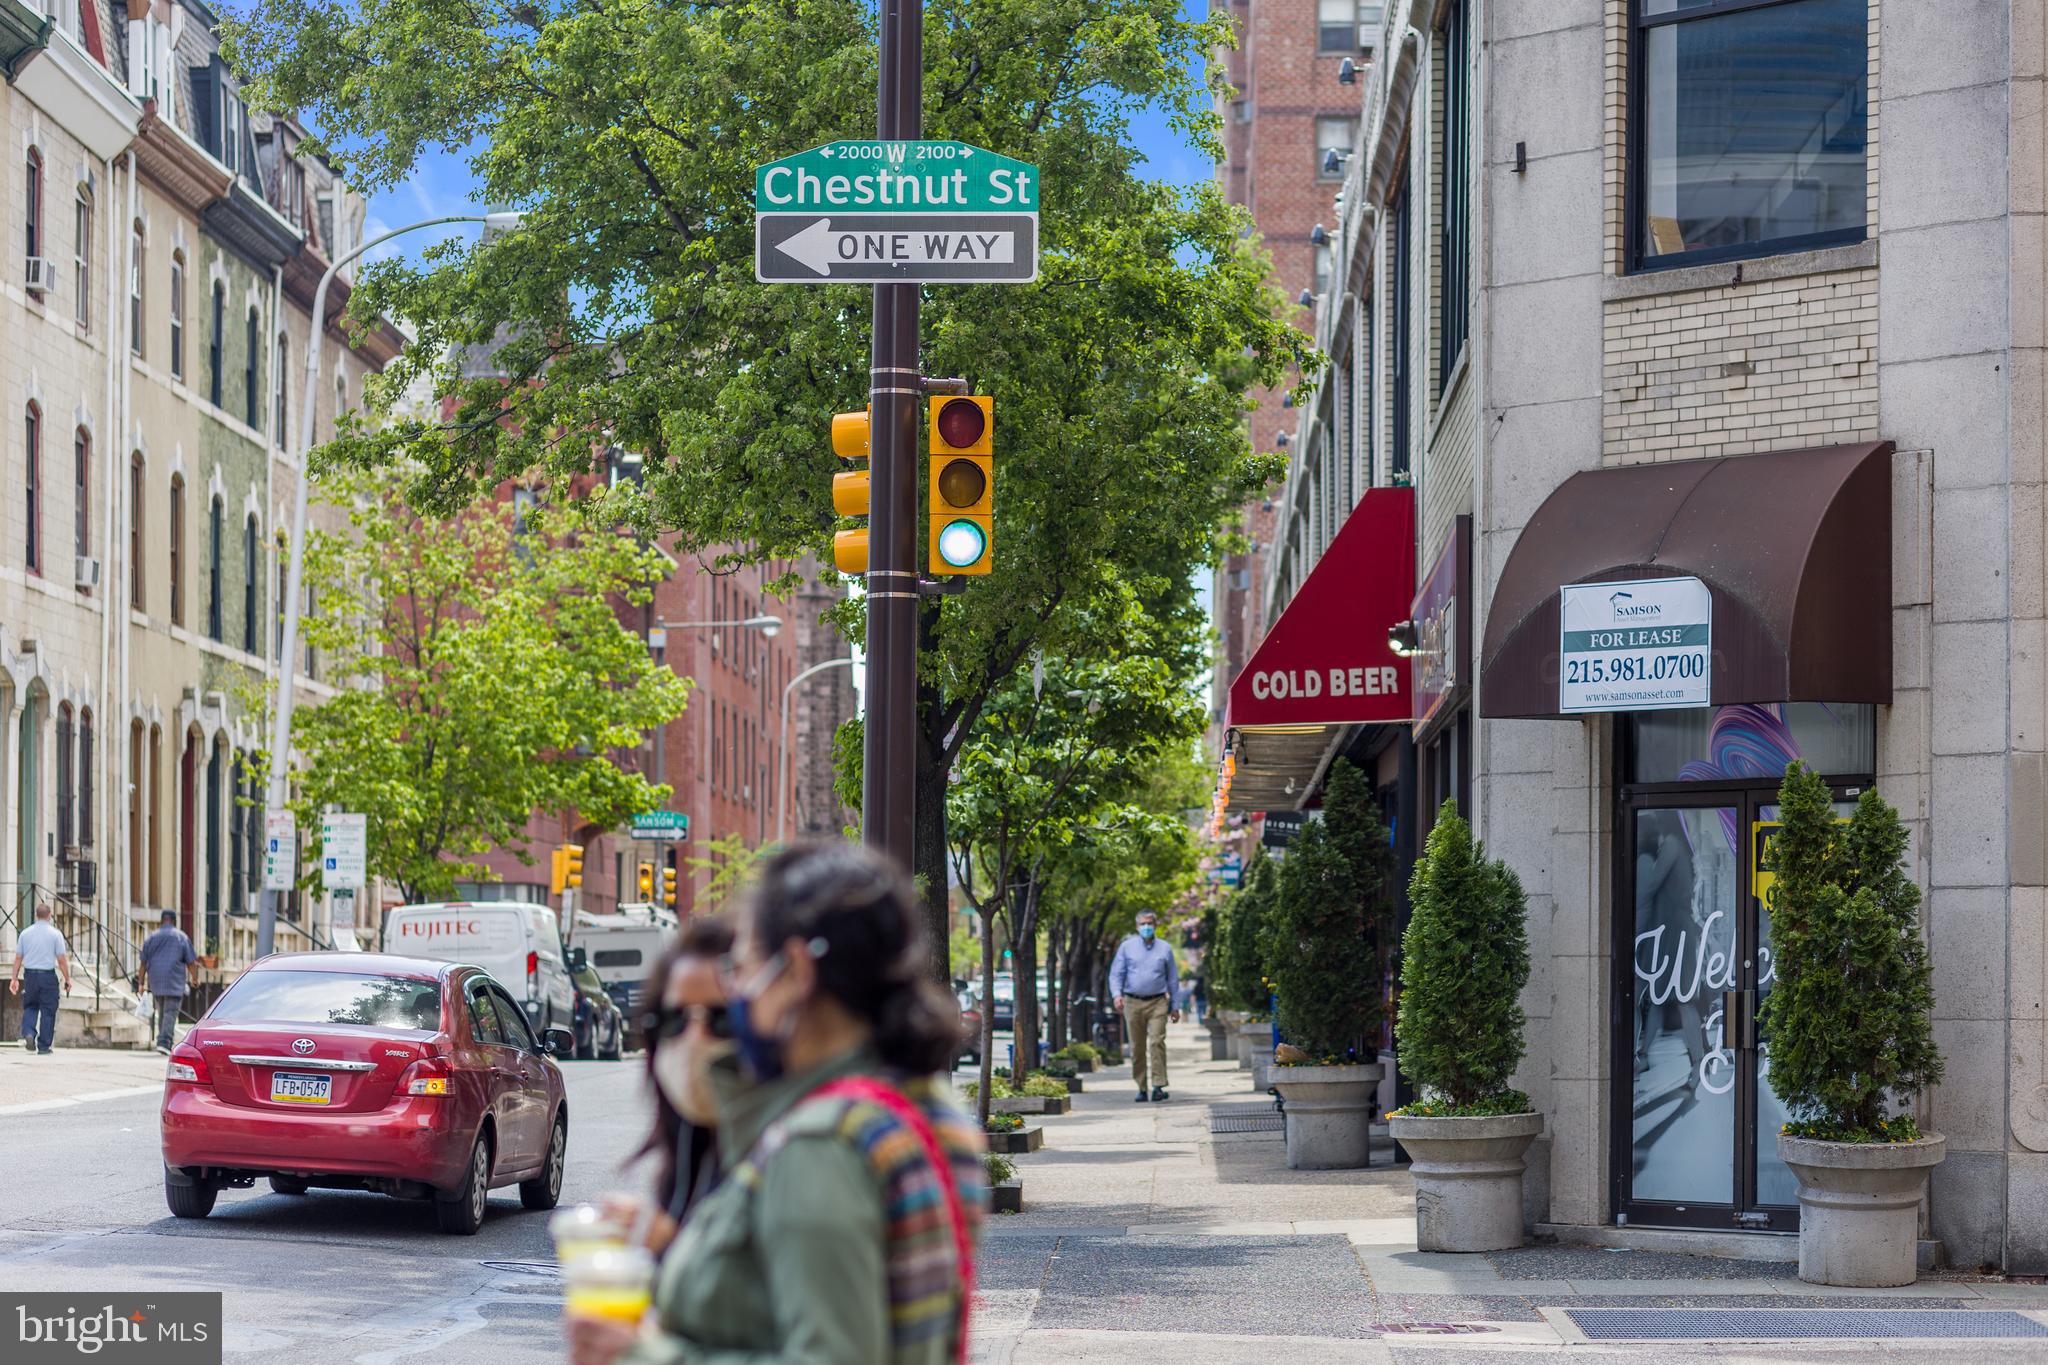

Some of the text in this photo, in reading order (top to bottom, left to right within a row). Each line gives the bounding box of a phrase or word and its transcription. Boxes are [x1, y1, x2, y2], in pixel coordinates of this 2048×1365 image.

[838, 143, 956, 163] 2000 W 2100
[763, 166, 1031, 205] Chestnut St
[837, 234, 1000, 260] ONE WAY
[1616, 604, 1662, 616] SAMSON
[1590, 629, 1682, 648] FOR LEASE
[1567, 653, 1704, 684] 215.981.0700
[1251, 666, 1399, 700] COLD BEER
[1585, 688, 1684, 702] www.samsonasset.com
[401, 919, 481, 940] FUJITEC
[385, 1049, 410, 1058] YARIS
